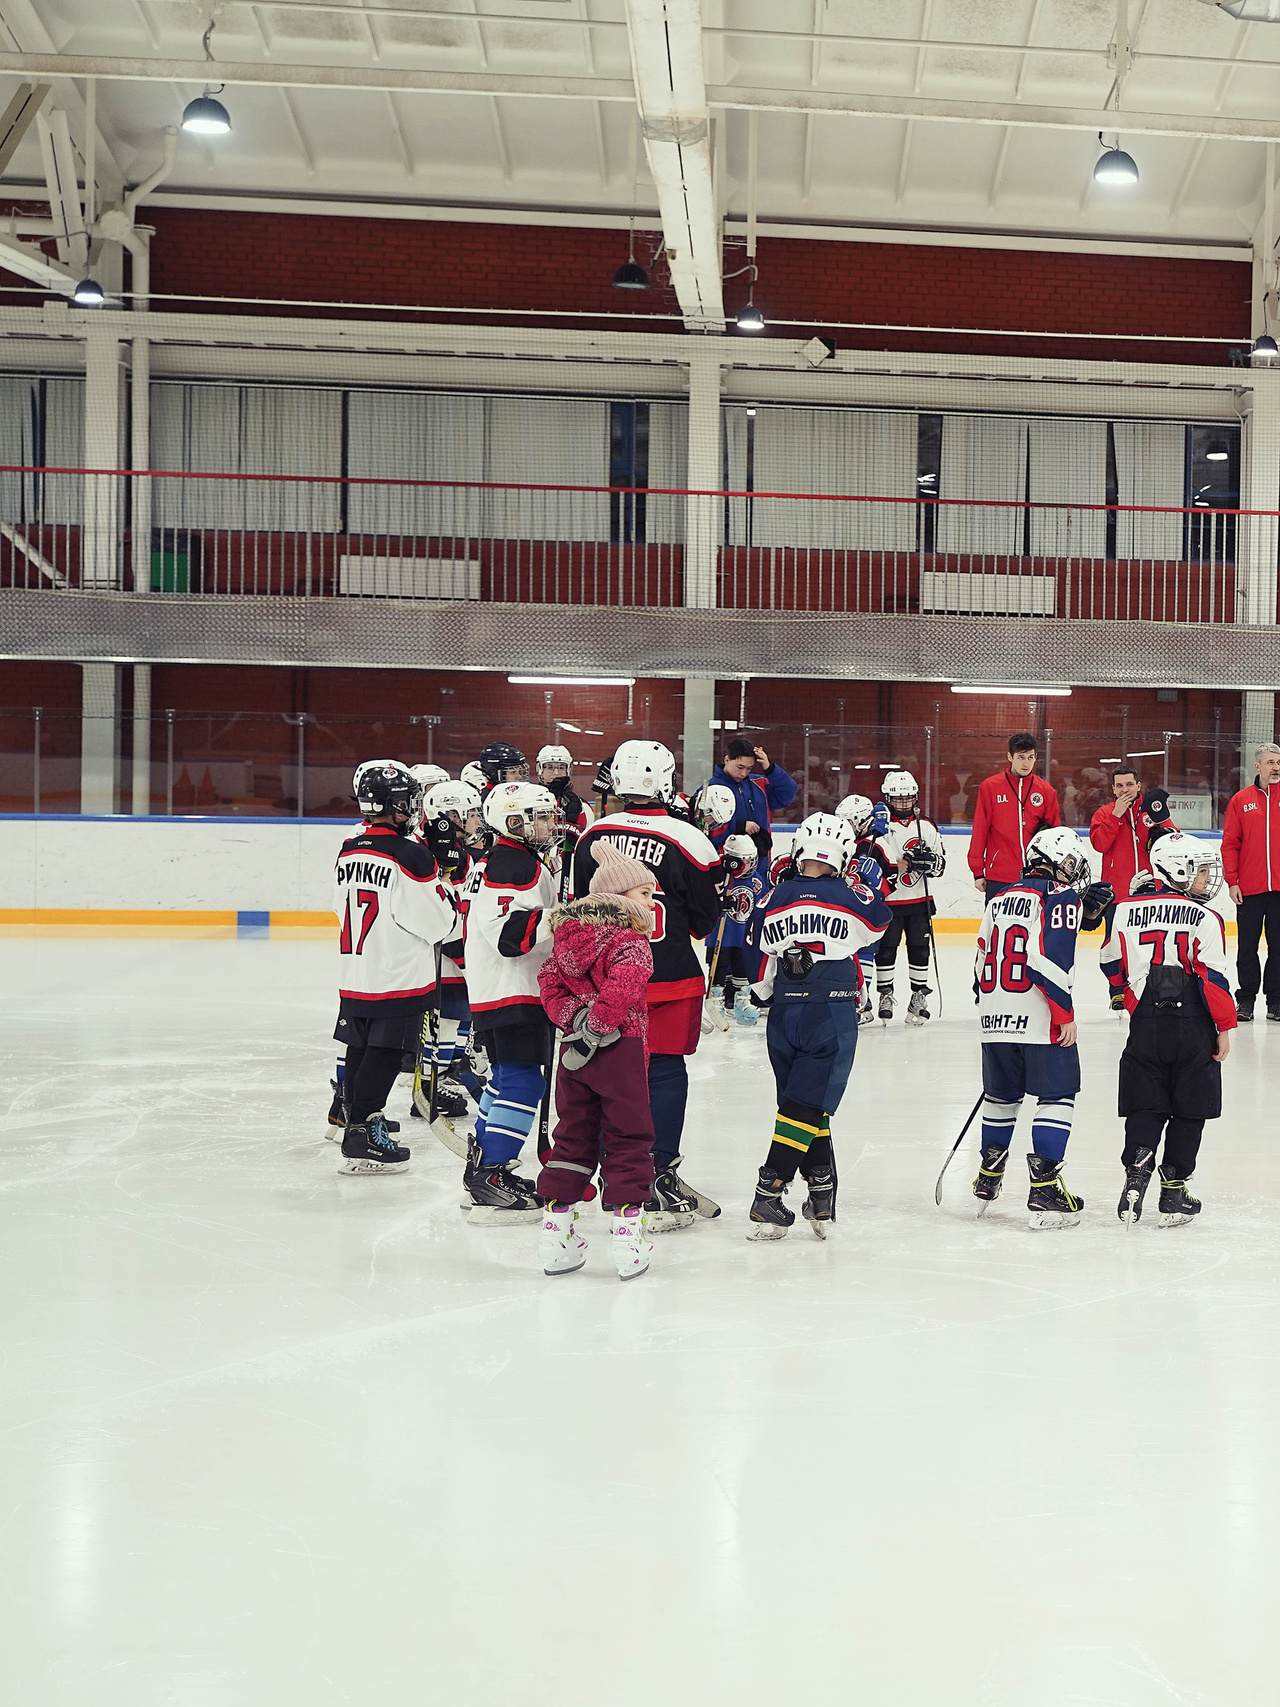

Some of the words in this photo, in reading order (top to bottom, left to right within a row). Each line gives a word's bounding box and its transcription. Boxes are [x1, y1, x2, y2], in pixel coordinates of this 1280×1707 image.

[825, 827, 832, 837] 5
[600, 835, 667, 868] ОБЕЕВ
[1051, 904, 1078, 930] 88
[1138, 929, 1194, 975] 71
